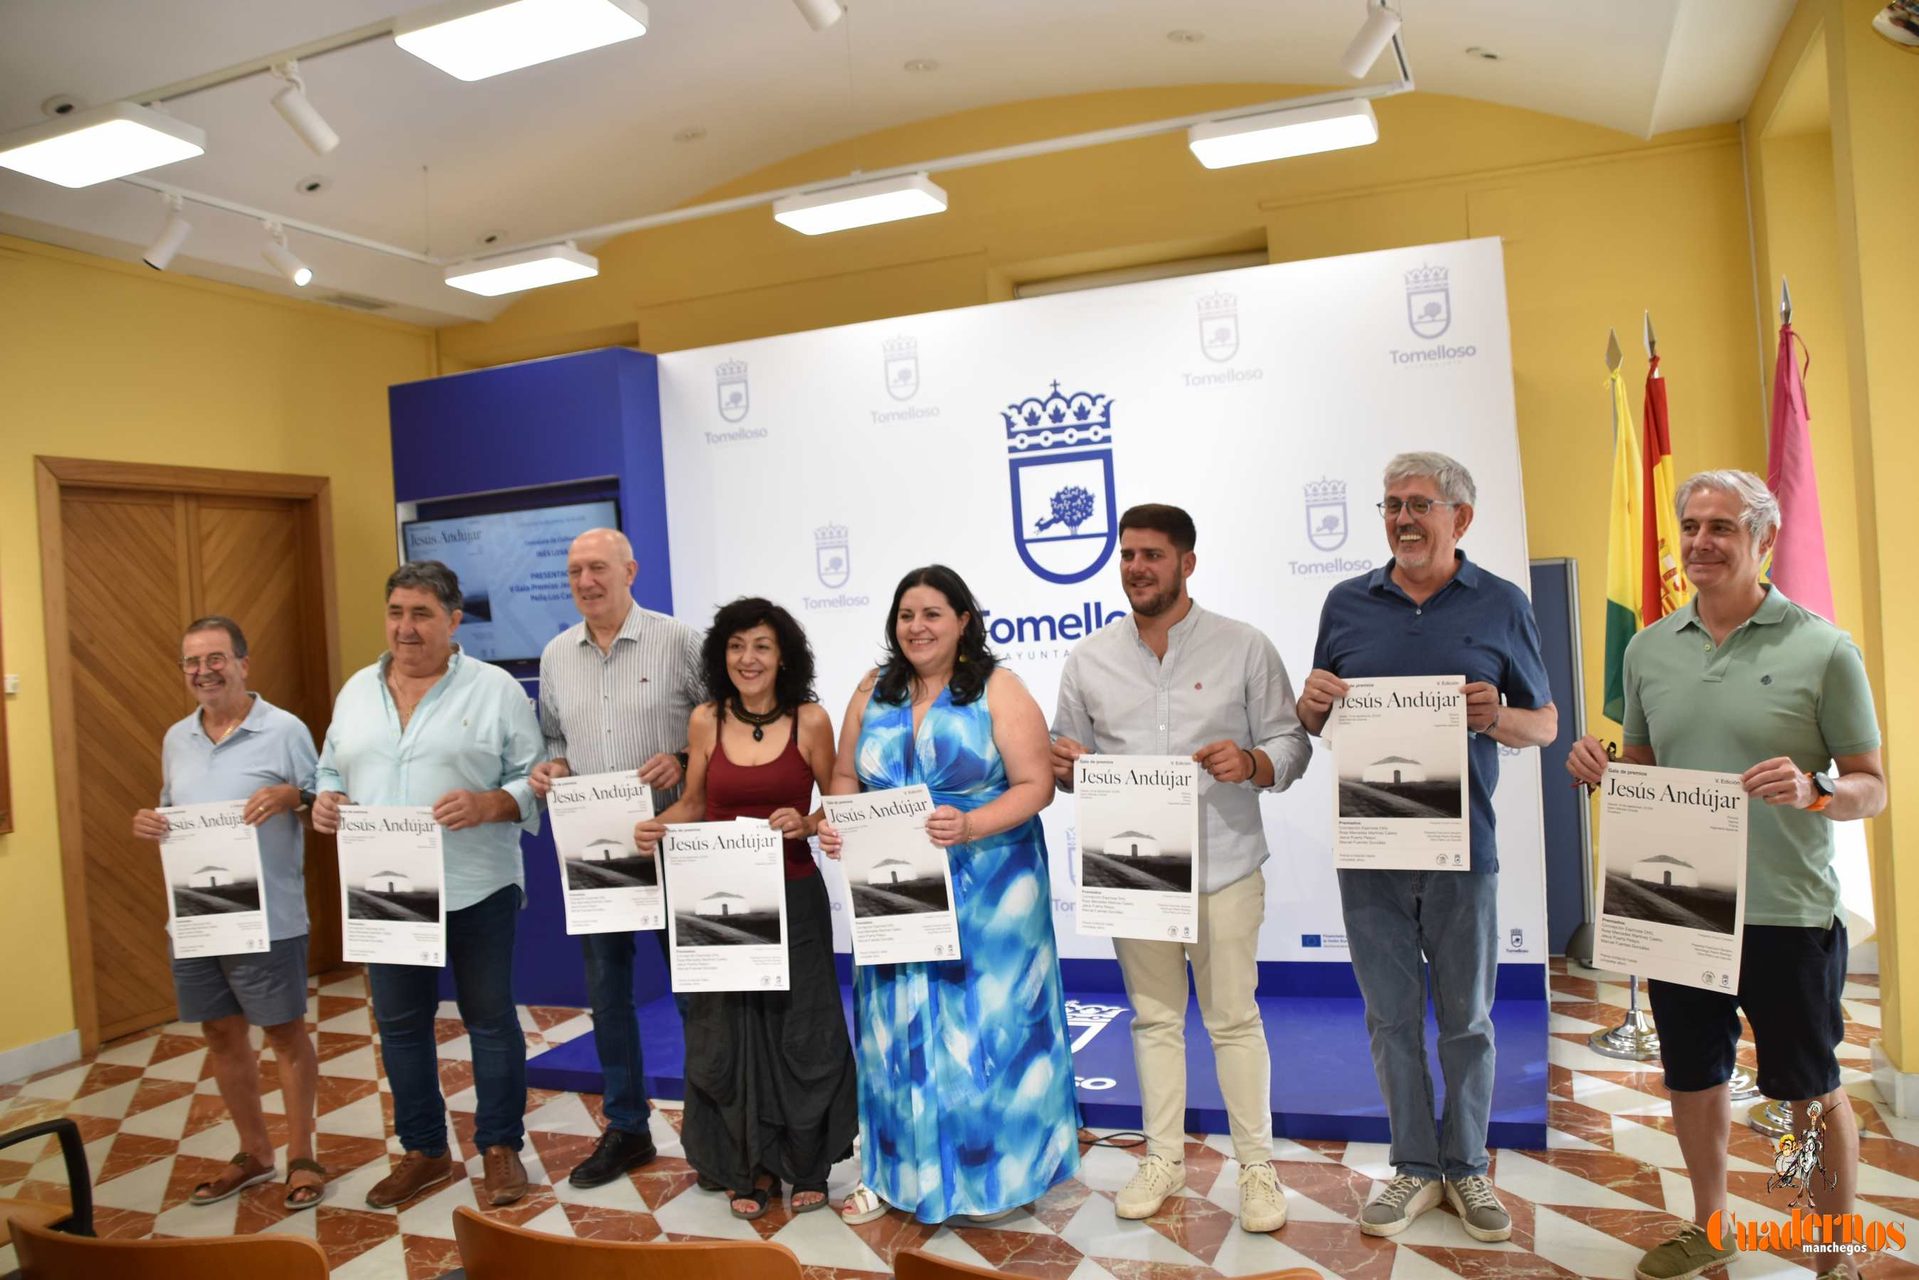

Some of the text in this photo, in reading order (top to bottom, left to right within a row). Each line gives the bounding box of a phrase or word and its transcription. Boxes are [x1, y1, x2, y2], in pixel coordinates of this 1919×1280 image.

[1389, 344, 1477, 364] Tomelloso
[1181, 366, 1264, 387] Tomelloso
[871, 405, 940, 425] Tomelloso
[704, 426, 769, 445] Tomelloso
[1288, 557, 1374, 575] Tomelloso
[803, 594, 870, 610] Tomelloso
[981, 601, 1127, 644] omell
[1006, 650, 1071, 661] AYUNTA
[1339, 691, 1460, 712] Jesús Andújar
[1080, 768, 1192, 791] Jesús Andújar
[552, 783, 645, 804] Jesús Andújar
[1607, 778, 1656, 801] Jesús
[1659, 784, 1741, 813] Andújar
[830, 799, 928, 823] Jesús Andújar
[167, 812, 245, 831] esús Andúja
[339, 817, 436, 836] Jesús Andújar
[669, 833, 777, 852] Jesús Andújar
